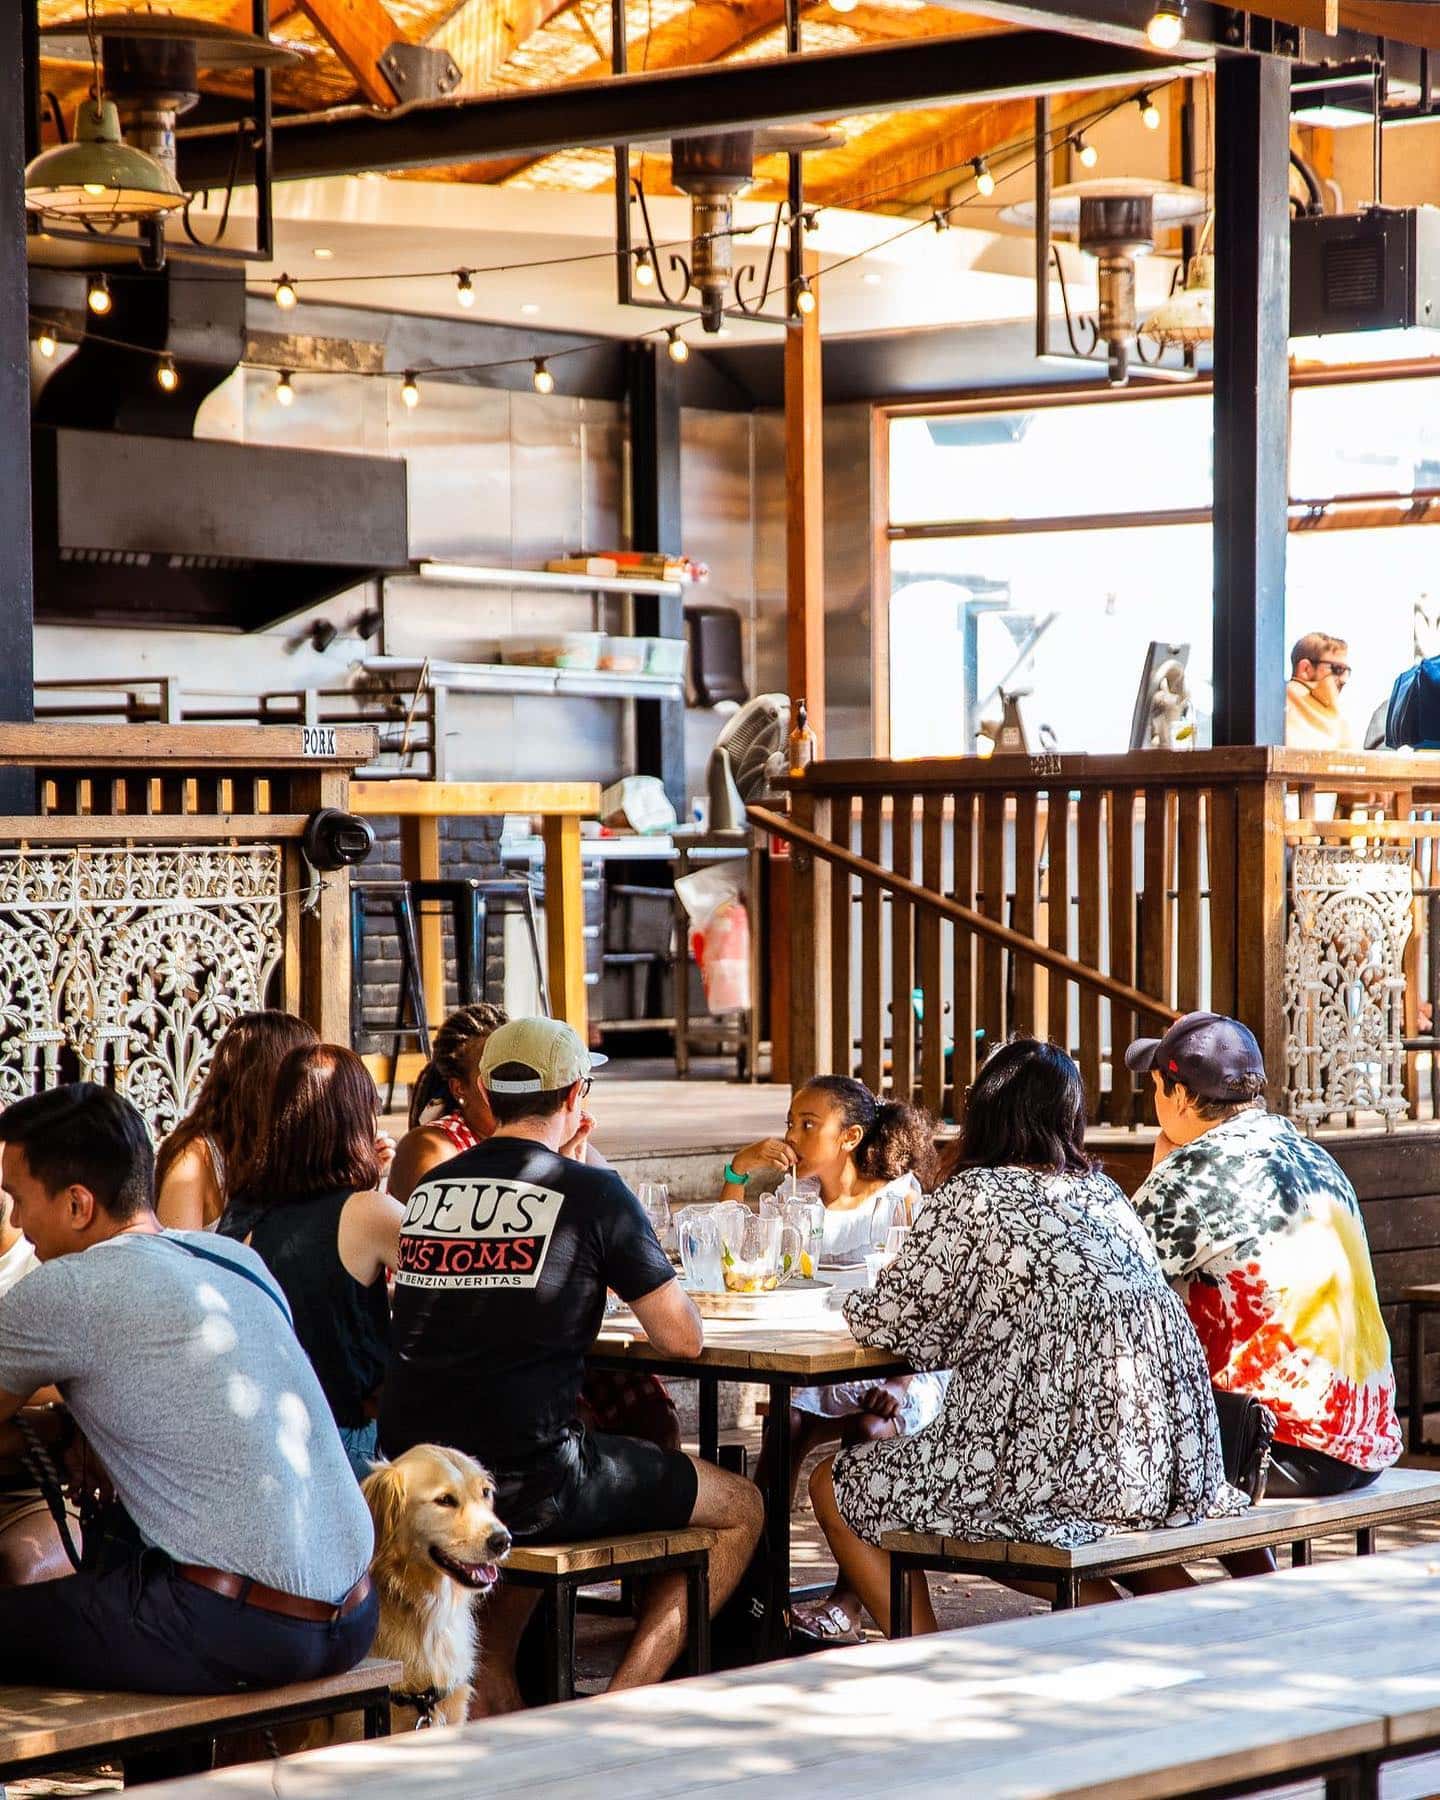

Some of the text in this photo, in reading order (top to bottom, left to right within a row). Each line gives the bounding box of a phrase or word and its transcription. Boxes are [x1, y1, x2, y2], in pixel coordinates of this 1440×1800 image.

[303, 728, 335, 754] PORK
[403, 1184, 547, 1233] DEUS
[405, 1274, 447, 1286] BENZIN
[454, 1276, 522, 1286] VERITAS
